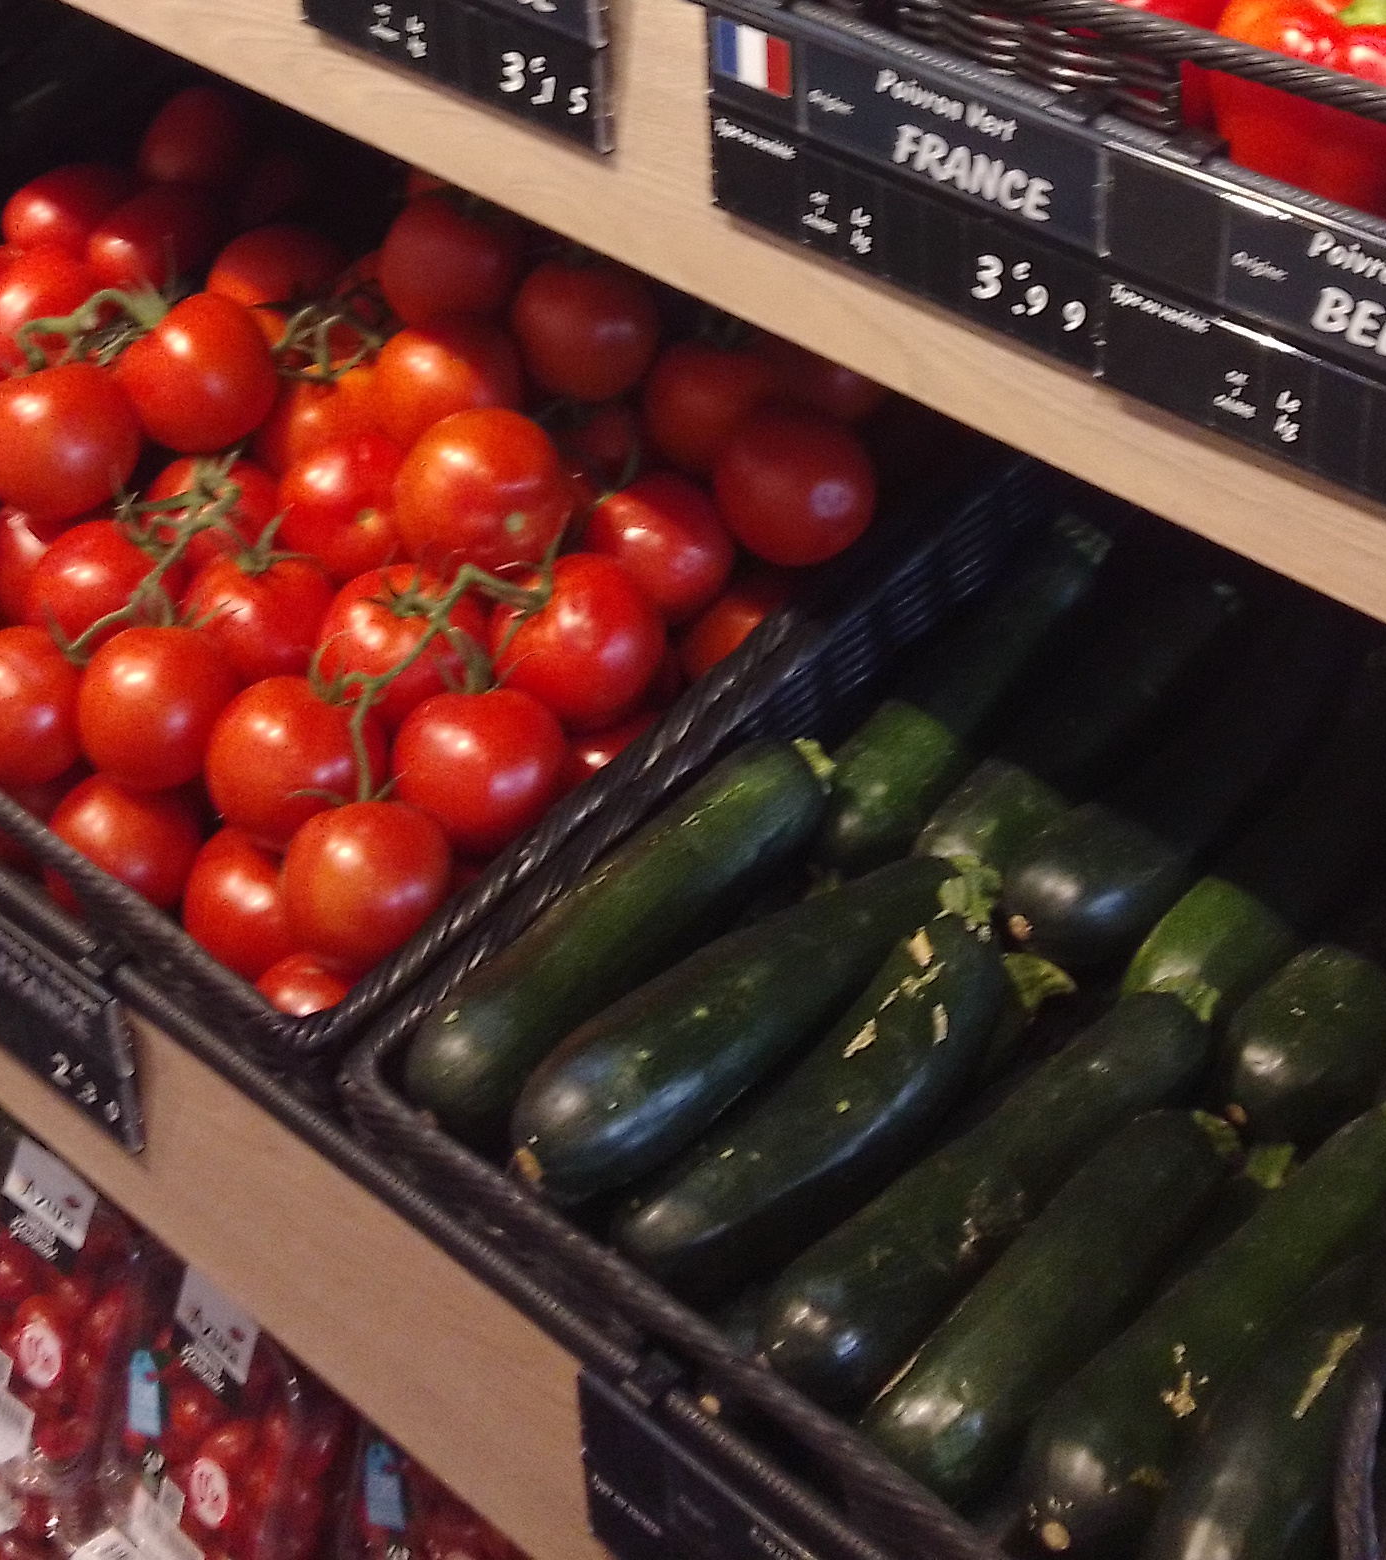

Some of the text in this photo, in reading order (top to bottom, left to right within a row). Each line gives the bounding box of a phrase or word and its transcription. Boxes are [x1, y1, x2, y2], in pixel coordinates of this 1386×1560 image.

[874, 67, 1019, 143] Poivron Vert
[890, 123, 1056, 223] FRANCE
